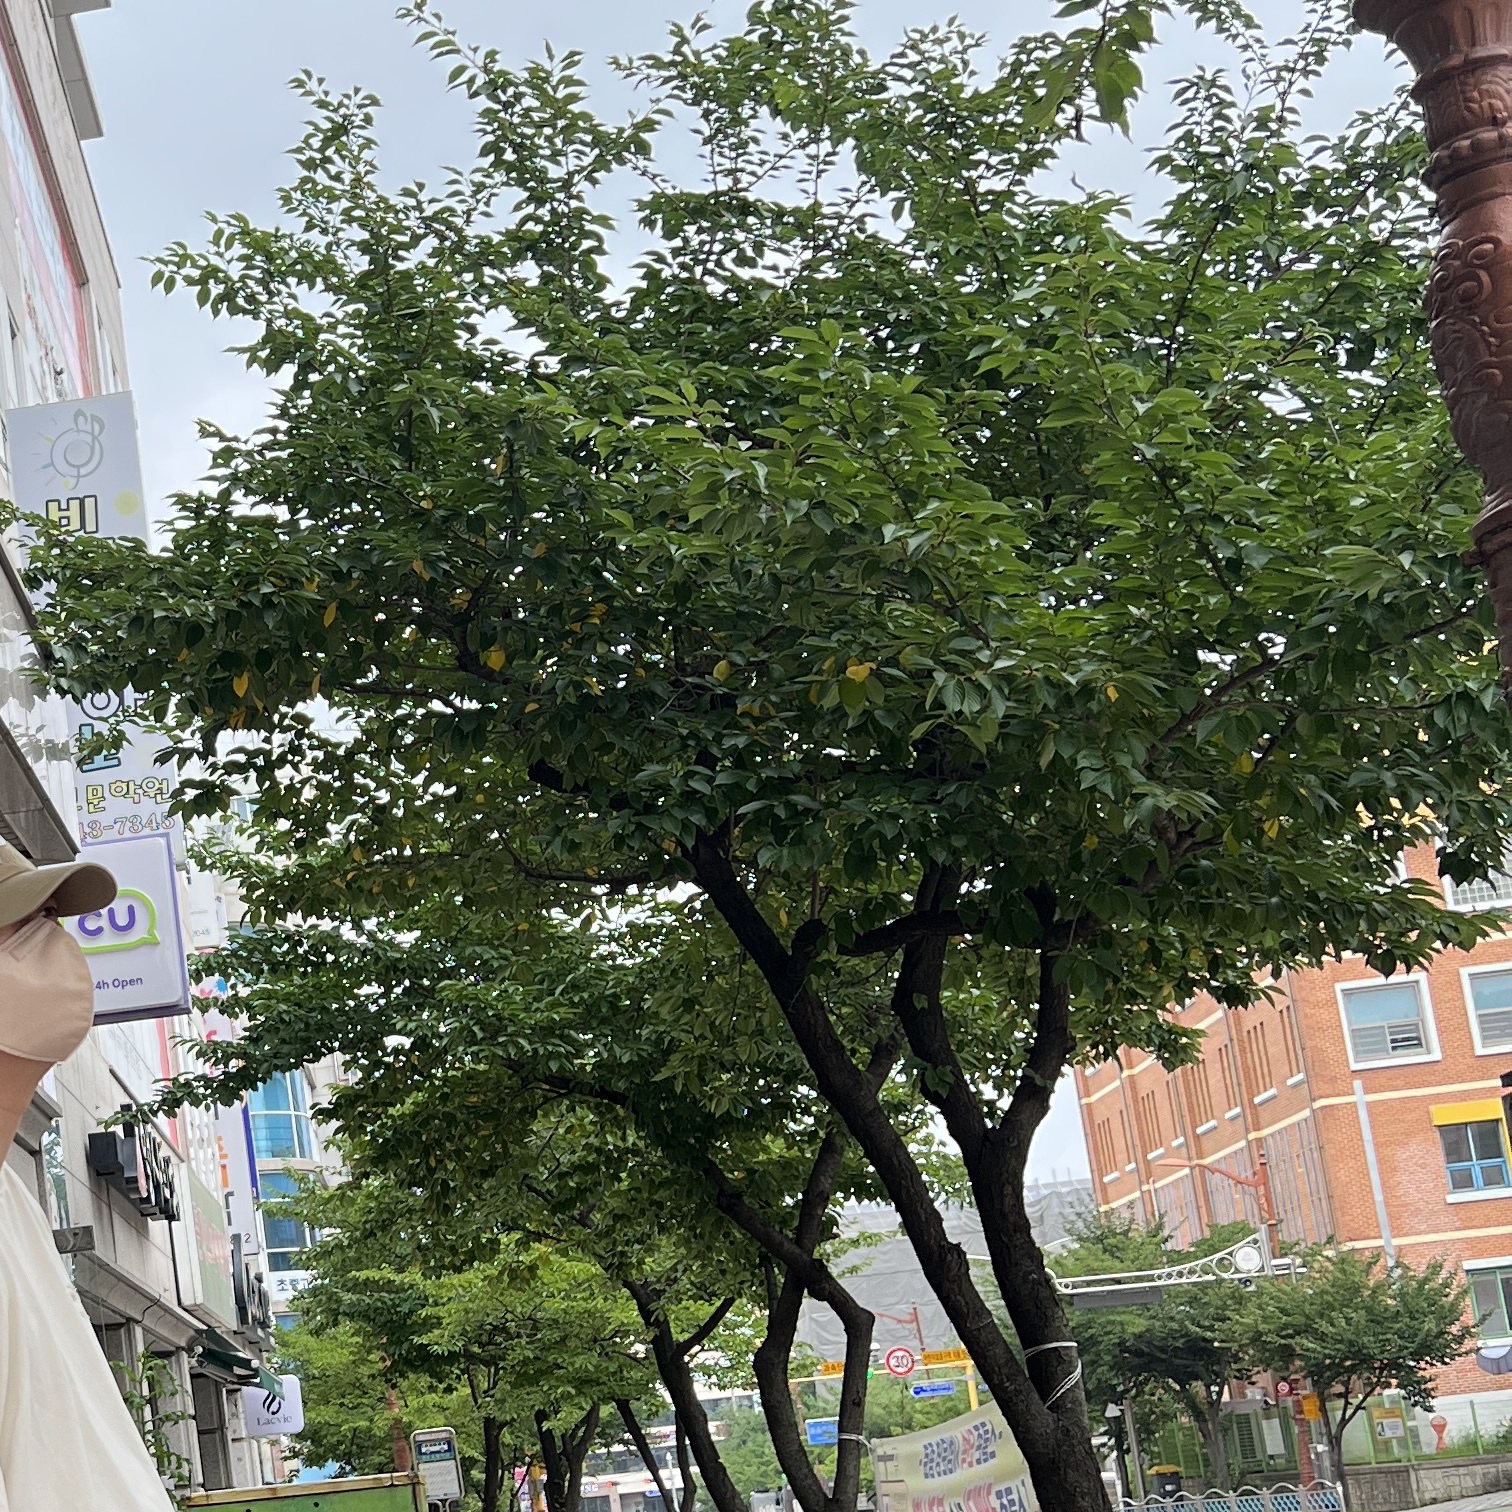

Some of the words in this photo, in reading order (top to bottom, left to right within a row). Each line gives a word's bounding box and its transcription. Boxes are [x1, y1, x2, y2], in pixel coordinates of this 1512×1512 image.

[75, 776, 173, 815] 문학원
[77, 903, 136, 937] CU
[93, 980, 109, 990] 4h
[112, 977, 144, 990] Open
[892, 1354, 909, 1368] 30
